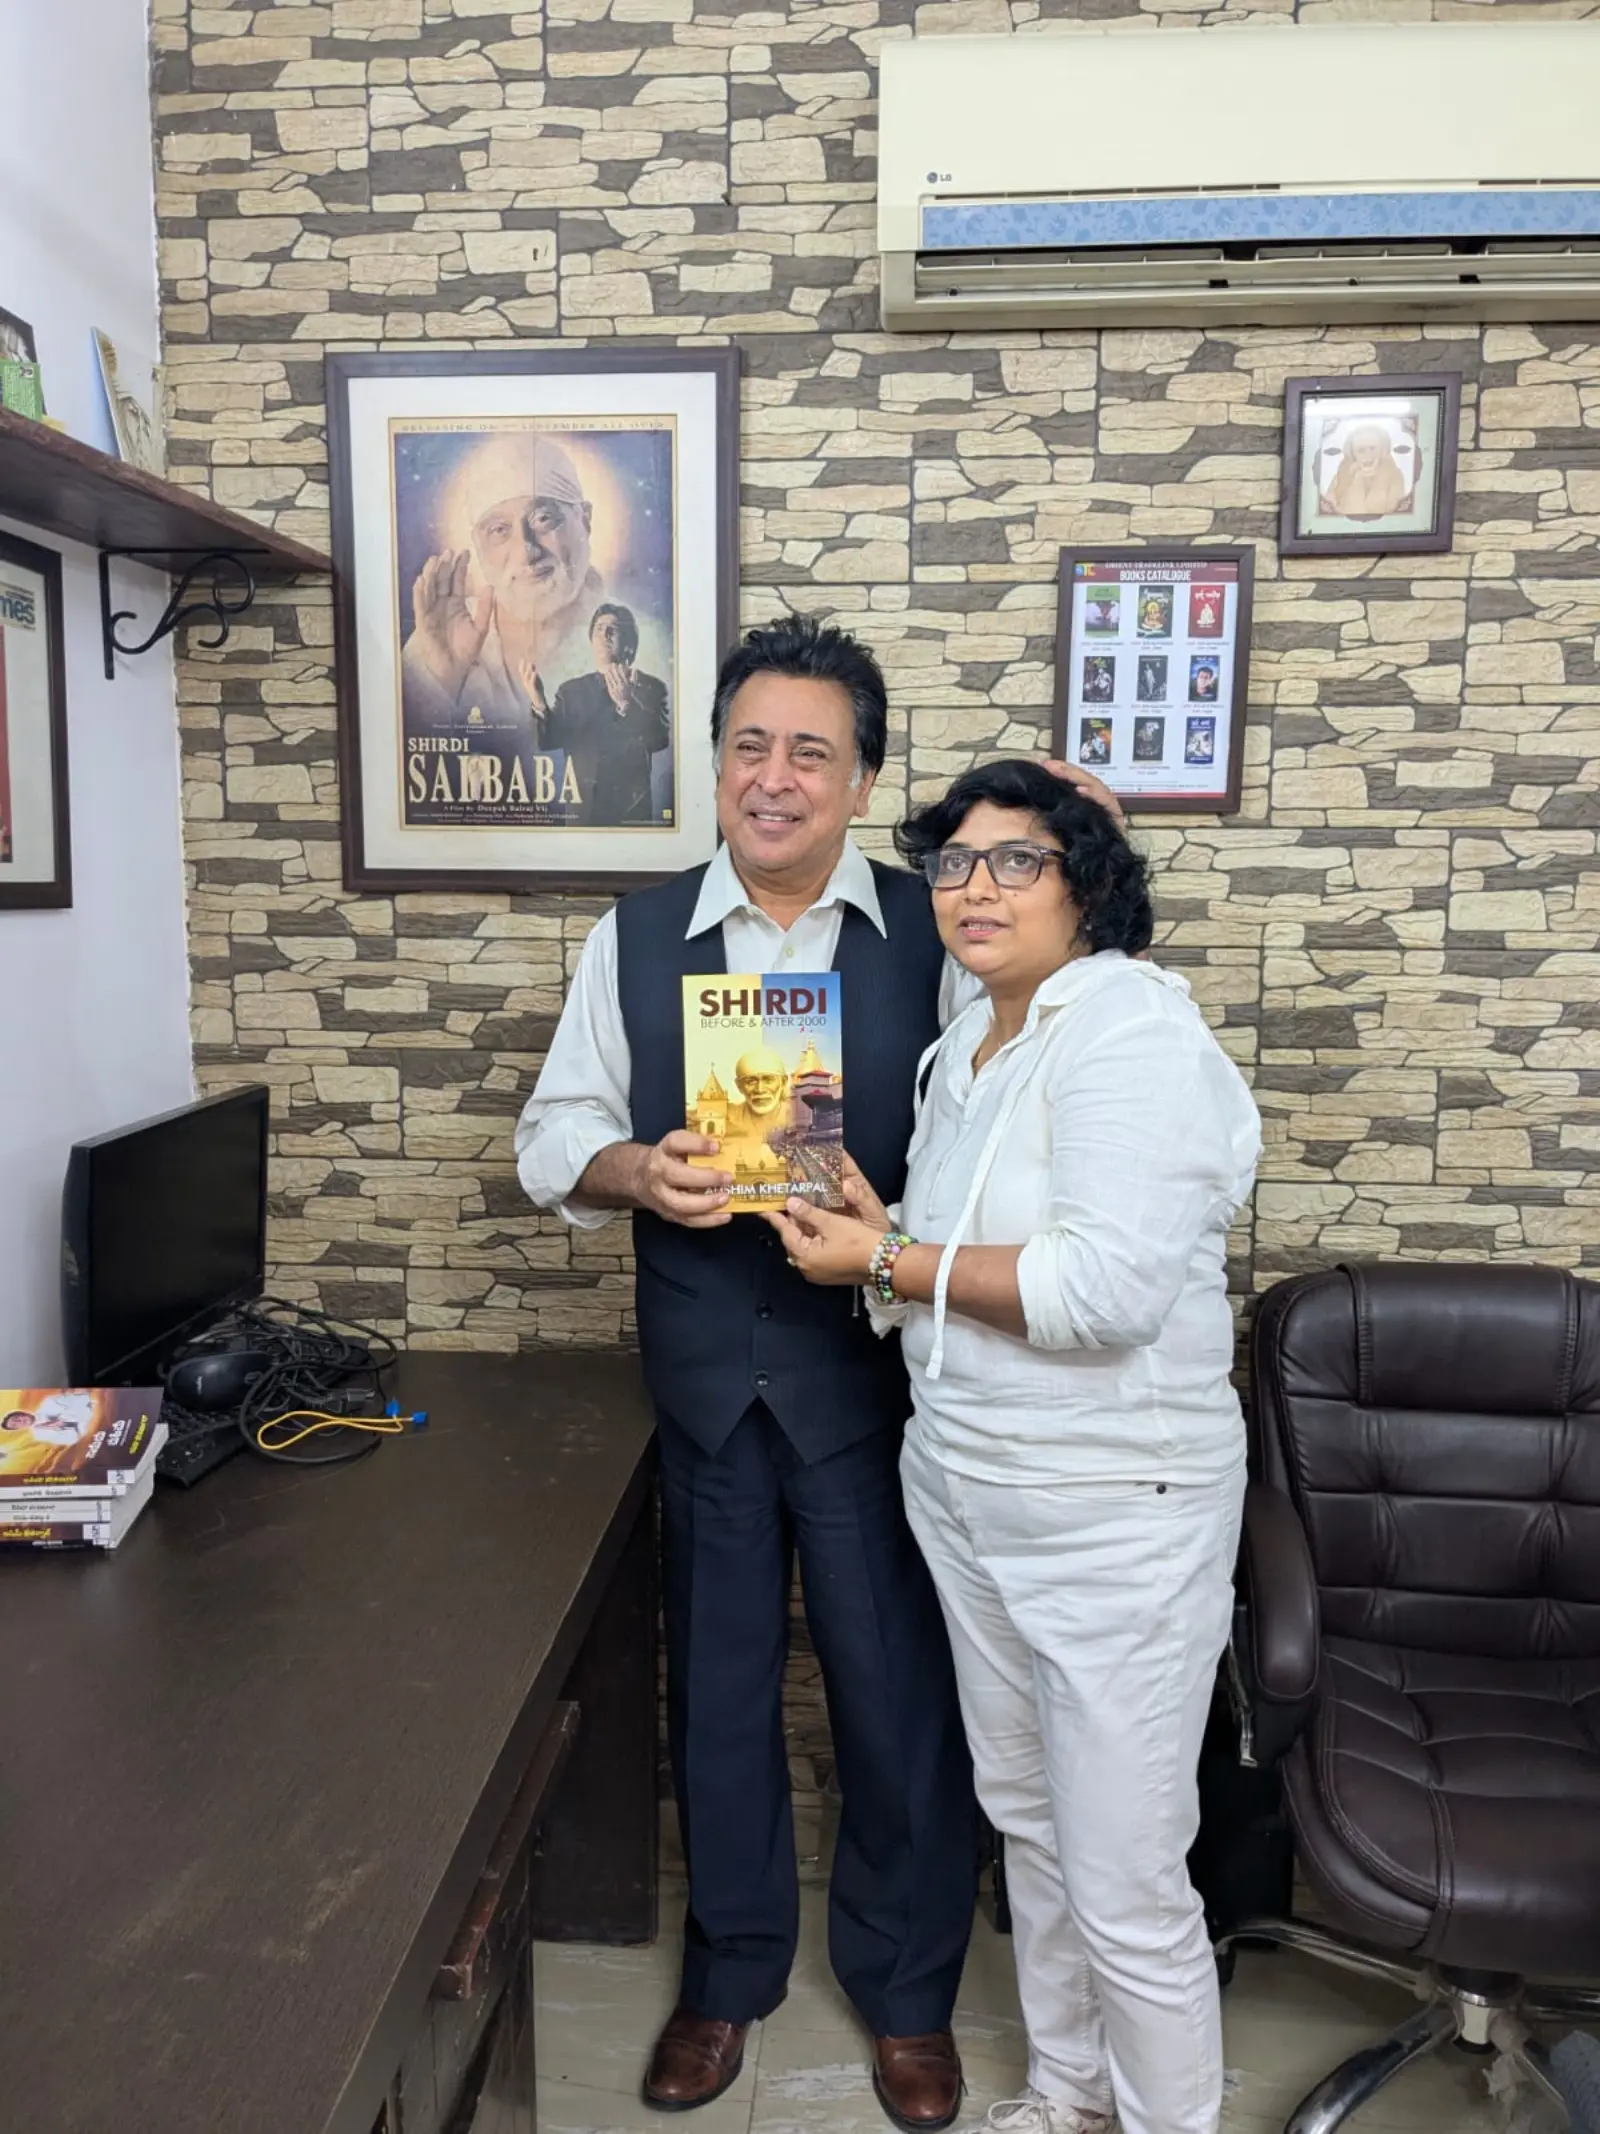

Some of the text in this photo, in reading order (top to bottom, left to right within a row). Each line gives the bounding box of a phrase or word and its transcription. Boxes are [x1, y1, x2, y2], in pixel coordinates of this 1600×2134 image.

[940, 174, 952, 182] LG
[1120, 570, 1192, 581] BOOKS CATALOGUE
[407, 737, 469, 752] SHIRDI
[699, 988, 827, 1017] SHIRDI
[701, 1016, 827, 1029] BEFORE & AFTER 2000
[759, 1182, 829, 1195] KHETARPAL
